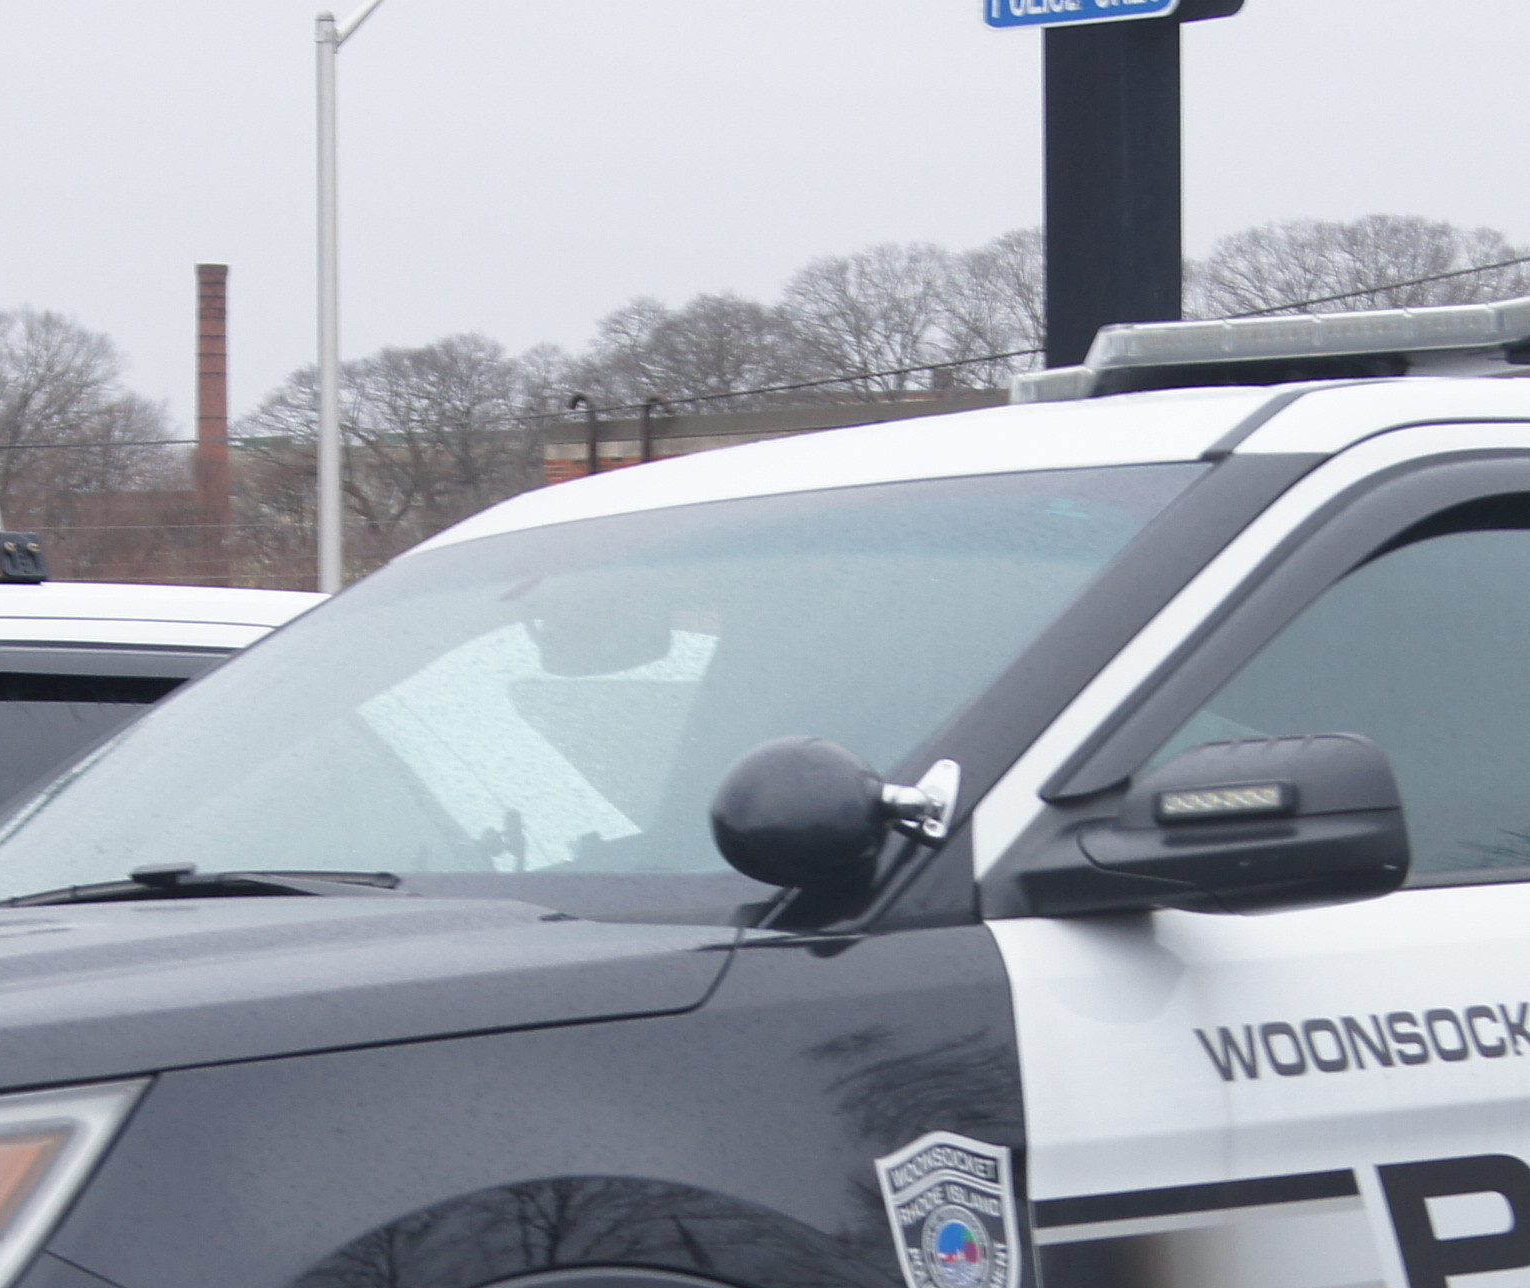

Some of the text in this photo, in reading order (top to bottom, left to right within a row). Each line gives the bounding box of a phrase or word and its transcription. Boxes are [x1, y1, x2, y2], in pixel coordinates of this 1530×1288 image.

[891, 1146, 997, 1190] WOONSOCKET
[898, 1184, 1002, 1226] RHODE ISLAND
